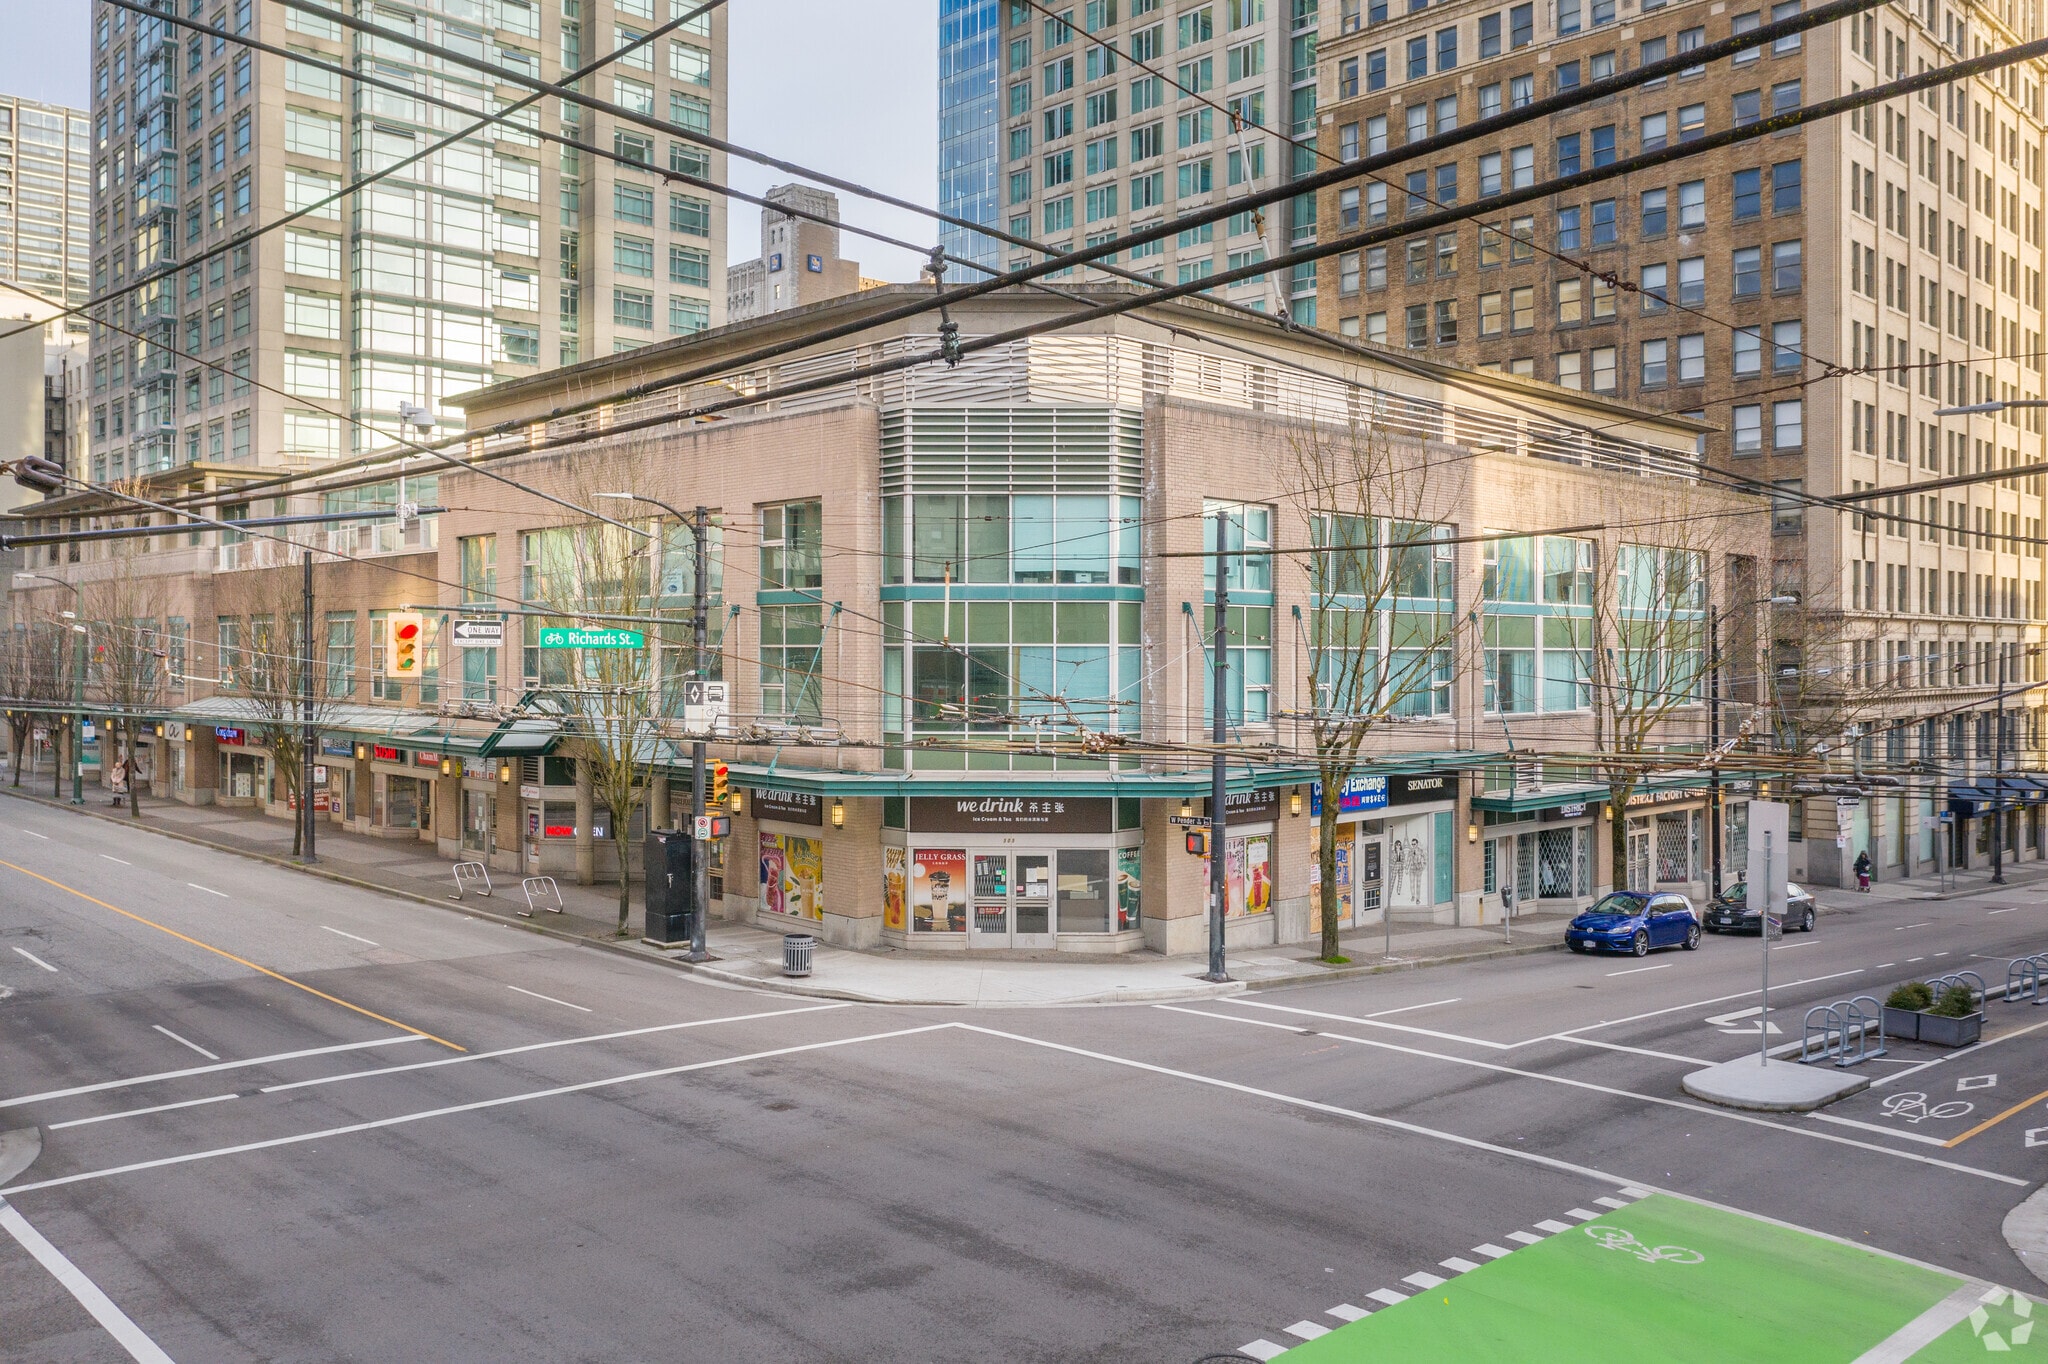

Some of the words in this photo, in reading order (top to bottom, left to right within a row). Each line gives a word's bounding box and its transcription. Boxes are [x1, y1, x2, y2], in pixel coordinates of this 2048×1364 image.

[467, 626, 482, 634] ONE
[568, 632, 617, 645] Richards
[619, 633, 635, 645] St.
[373, 744, 397, 760] SUSHI
[1350, 775, 1386, 793] Exchange
[1407, 777, 1444, 791] SENATOR
[1656, 790, 1683, 802] FACTORY
[1561, 802, 1586, 814] DISTRICT
[1177, 817, 1195, 825] Pender
[545, 825, 573, 837] NOW
[915, 853, 939, 861] JELLY
